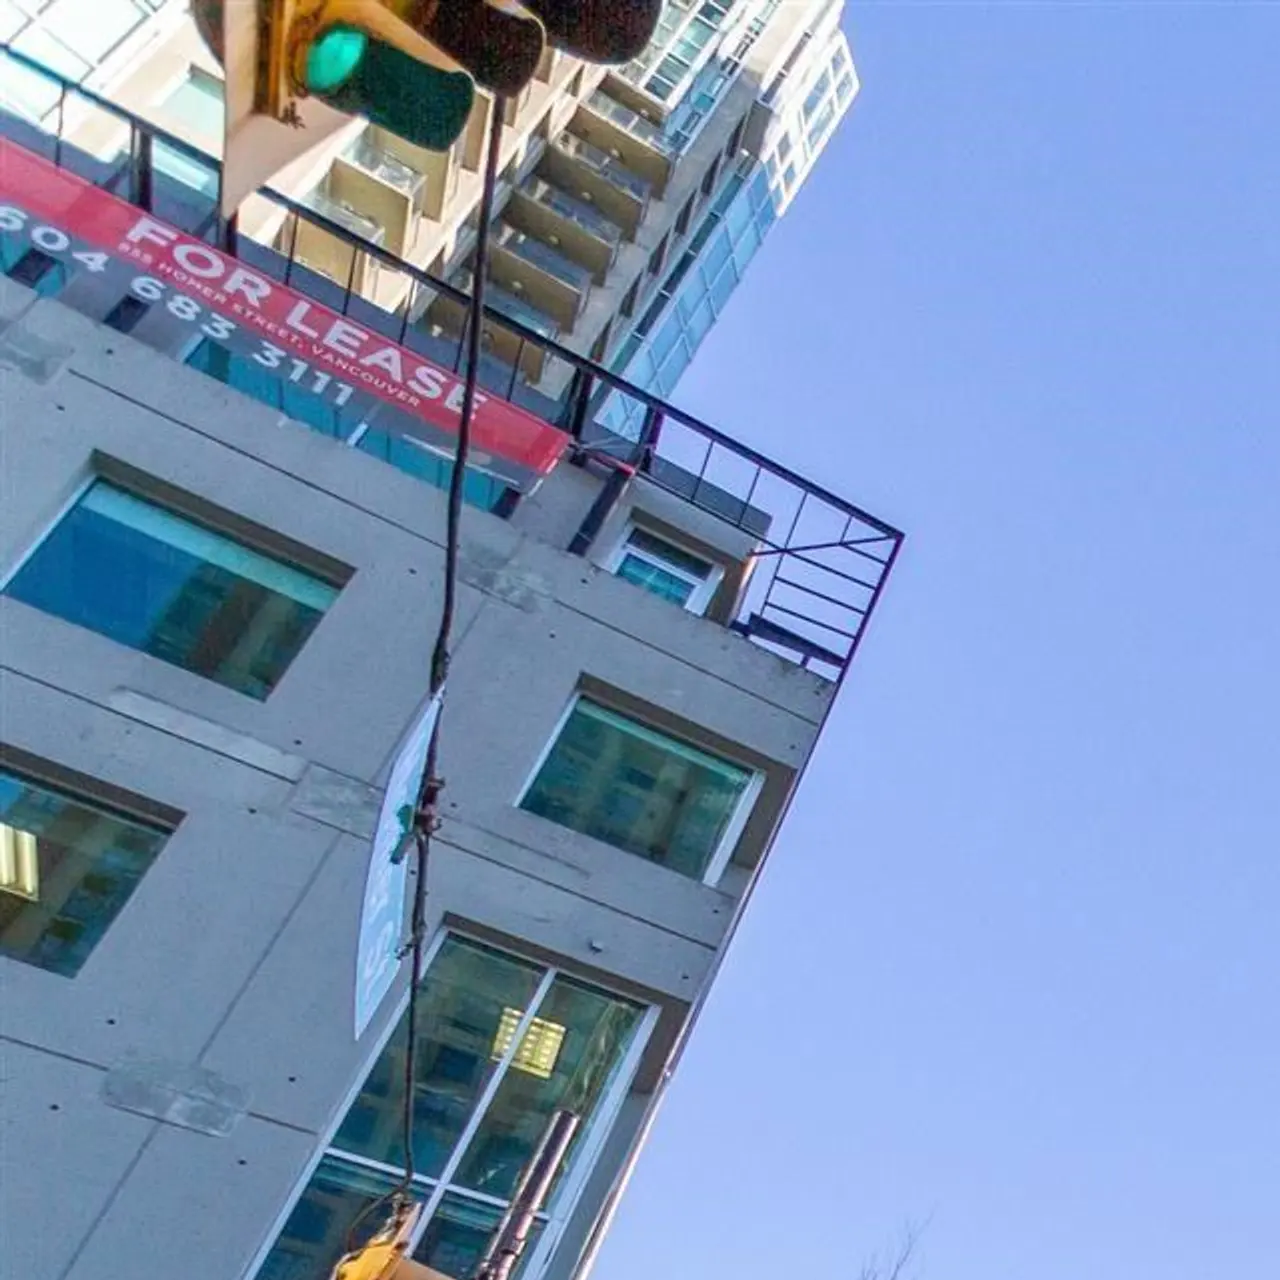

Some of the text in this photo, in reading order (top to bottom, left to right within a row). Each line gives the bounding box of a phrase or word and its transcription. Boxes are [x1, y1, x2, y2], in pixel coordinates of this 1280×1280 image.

[0, 206, 354, 406] 604 683 3111
[126, 217, 488, 421] FOR LEASE
[157, 262, 227, 305] HOMER
[311, 343, 421, 408] VANCOUVER
